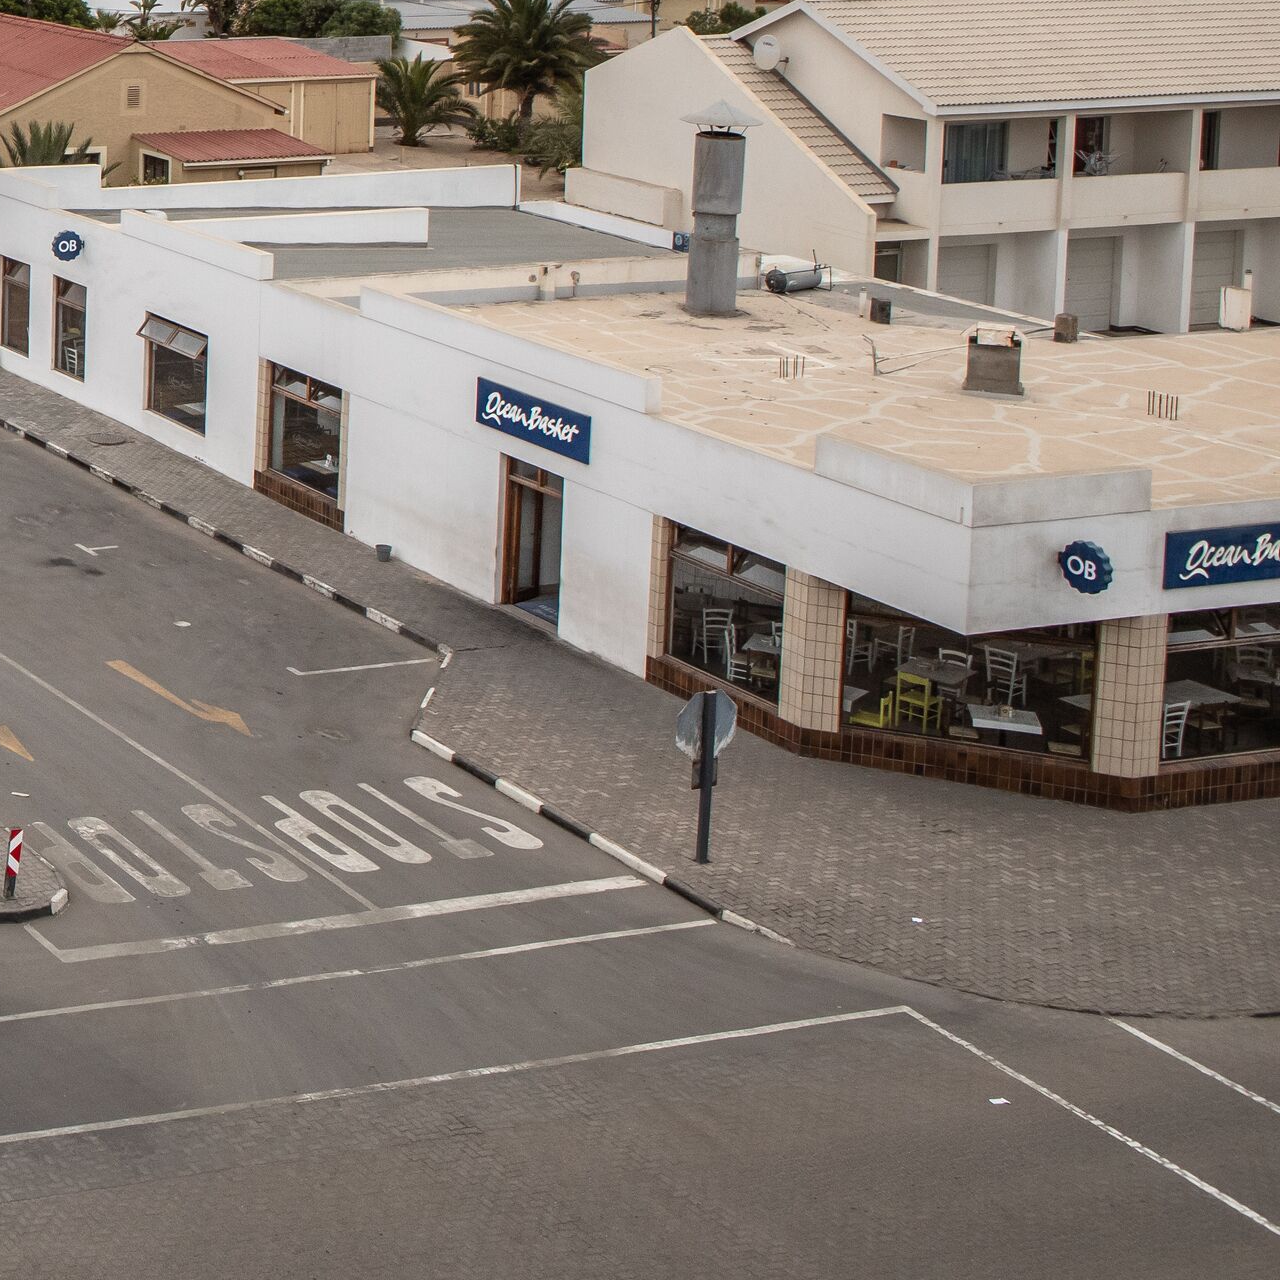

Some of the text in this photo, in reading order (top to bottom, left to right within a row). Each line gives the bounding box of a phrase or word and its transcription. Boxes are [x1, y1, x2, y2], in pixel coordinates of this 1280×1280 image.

[59, 240, 76, 252] OB
[482, 392, 579, 442] Ocean Basket
[1067, 556, 1096, 580] OB
[1179, 540, 1252, 580] Ocean
[264, 776, 544, 872] STOP
[32, 804, 309, 903] STOP
